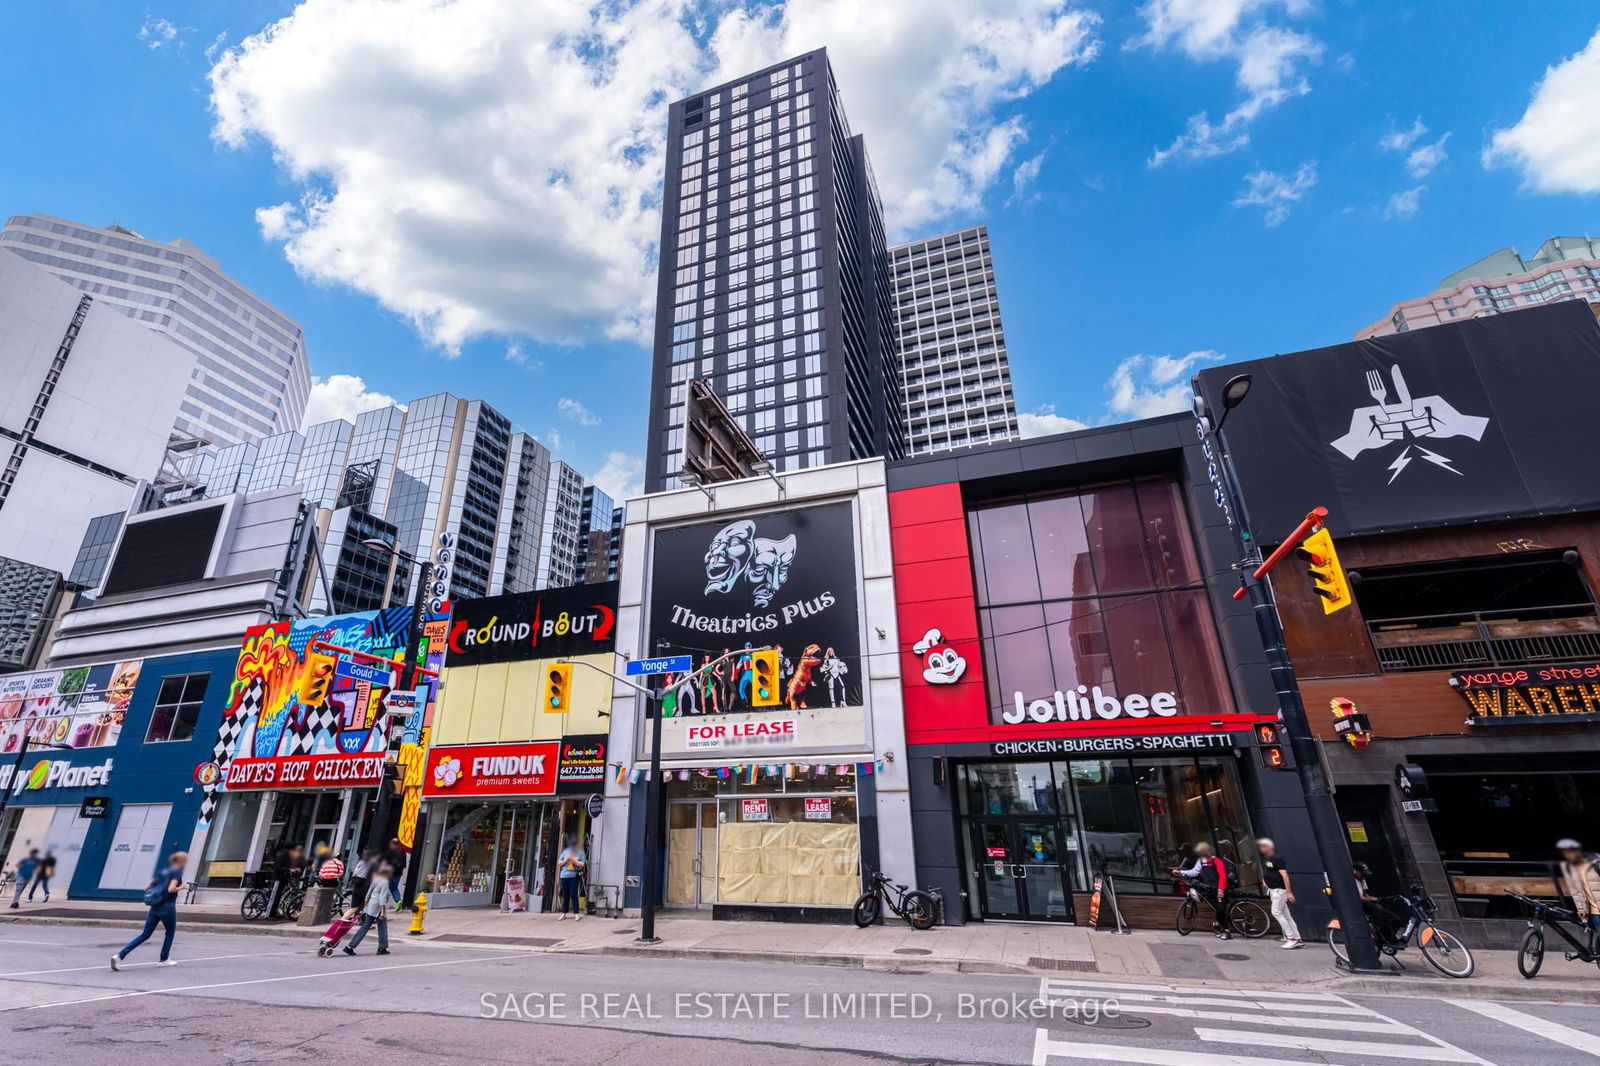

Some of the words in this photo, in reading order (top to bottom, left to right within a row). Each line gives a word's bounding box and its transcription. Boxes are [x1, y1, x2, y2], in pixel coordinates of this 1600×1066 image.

[418, 567, 434, 632] DOWNTOWN
[671, 604, 779, 634] Theatrics
[781, 591, 836, 625] Plus
[350, 665, 373, 679] Gould
[640, 659, 668, 672] Yonge
[1460, 670, 1529, 688] yonge
[1002, 685, 1177, 724] Jollibee
[689, 726, 726, 739] FOR
[733, 721, 794, 736] LEASE
[995, 741, 1057, 754] CHICKEN
[1063, 737, 1134, 751] BURGERS
[1143, 733, 1233, 749] SPAGHETTI
[471, 755, 546, 777] FUNDUK
[1271, 749, 1281, 766] 2
[45, 758, 114, 788] Planet
[228, 761, 277, 784] DAVE'S
[280, 761, 310, 782] HOT
[313, 757, 385, 781] CHICKEN
[560, 766, 604, 774] 647.712.2688
[476, 777, 510, 787] premium
[512, 776, 540, 785] sweets
[692, 781, 709, 791] 332
[744, 803, 766, 813] RENT
[805, 803, 829, 812] LEASE
